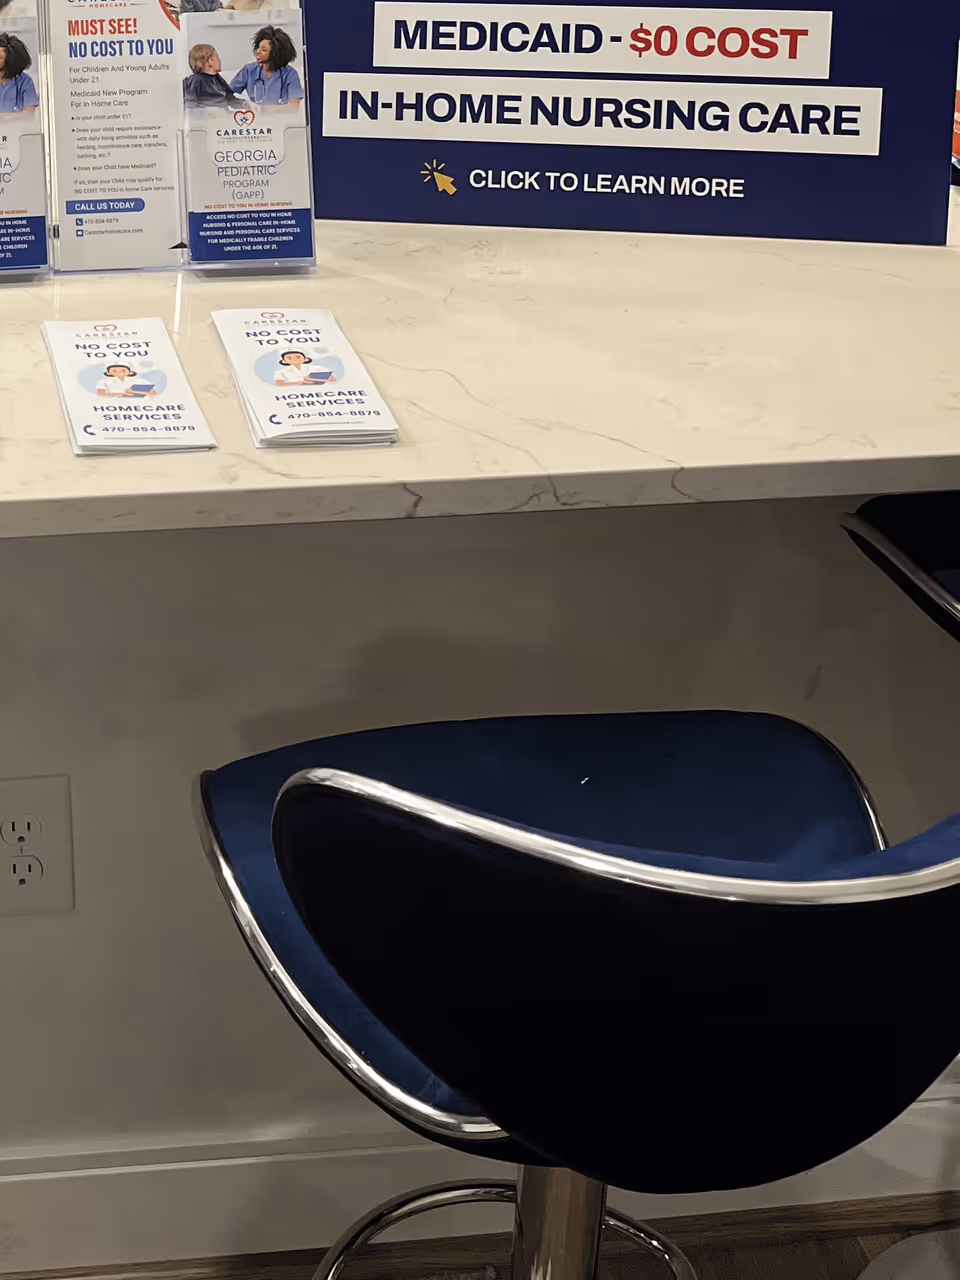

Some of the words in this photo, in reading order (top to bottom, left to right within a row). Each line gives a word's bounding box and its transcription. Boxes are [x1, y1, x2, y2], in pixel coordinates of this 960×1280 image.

[68, 19, 106, 36] MUST
[108, 18, 137, 35] SEE!
[393, 19, 602, 55] MEDICAID
[629, 22, 678, 58] $0
[685, 27, 808, 60] COST
[68, 41, 88, 58] NO
[90, 40, 124, 57] COST
[126, 39, 144, 56] TO
[146, 38, 174, 55] YOU
[81, 65, 110, 73] Children
[110, 64, 124, 72] And
[125, 64, 147, 73] Young
[148, 63, 170, 71] Adults
[69, 76, 90, 84] Under
[70, 89, 101, 98] Medicaid
[118, 88, 148, 98] Program
[70, 100, 82, 108] For
[112, 99, 129, 107] Care
[339, 89, 522, 125] IN-HOME
[530, 95, 730, 132] NURSING
[741, 101, 861, 137] CARE
[216, 128, 272, 137] CARESTAR
[214, 149, 277, 163] GEORGIA
[217, 165, 277, 177] PEDIATRIC
[223, 179, 270, 188] PROGRAM
[469, 169, 542, 192] CLICK
[545, 172, 579, 193] TO
[583, 173, 665, 195] LEARN
[669, 175, 745, 198] MORE
[231, 189, 264, 201] (GAPP)
[74, 202, 95, 211] CALL
[96, 202, 108, 210] US
[109, 201, 135, 210] TODAY
[245, 330, 271, 338] NO
[276, 328, 323, 336] COST
[106, 341, 152, 349] COST
[284, 336, 321, 344] YOU
[112, 350, 149, 358] YOU
[274, 389, 368, 401] HOMECARE
[93, 404, 186, 412] HOMECARE
[286, 398, 366, 408] SERVICES
[103, 413, 182, 421] SERVICES
